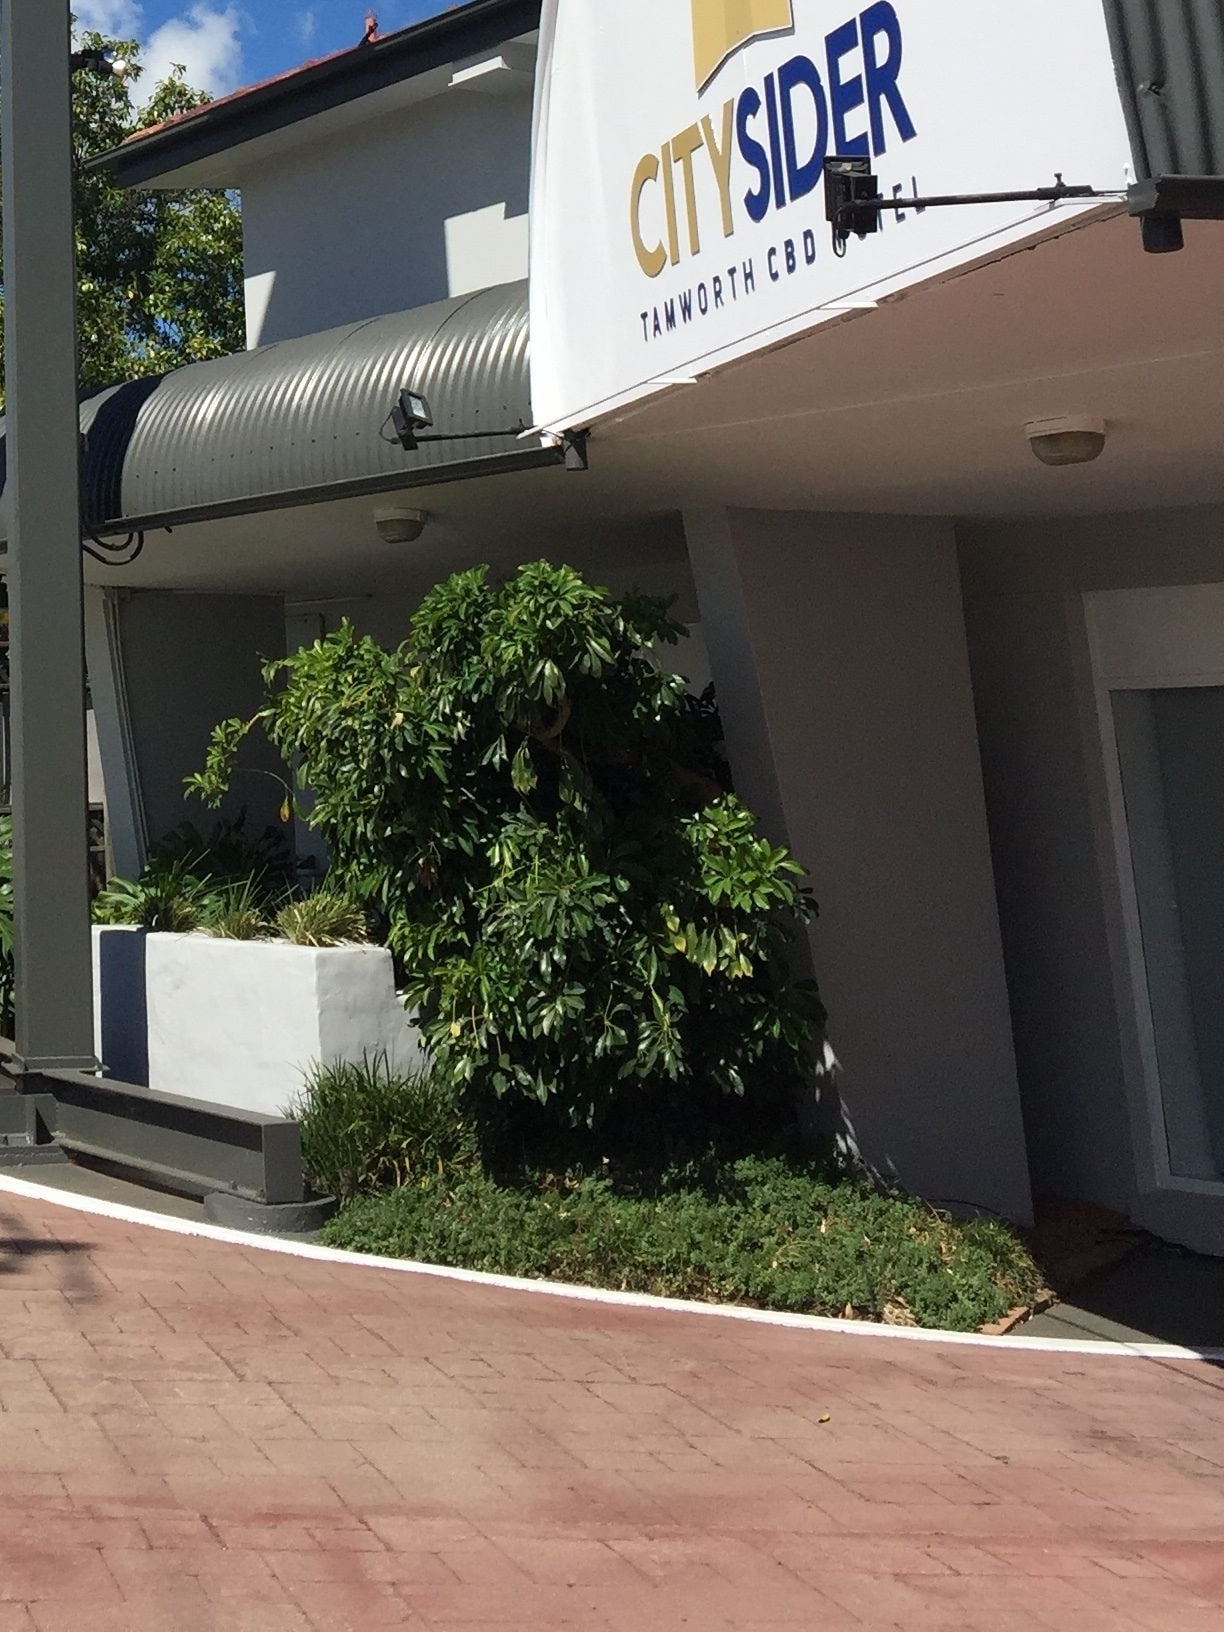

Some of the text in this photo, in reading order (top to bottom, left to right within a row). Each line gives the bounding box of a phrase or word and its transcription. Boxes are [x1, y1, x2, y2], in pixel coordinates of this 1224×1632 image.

[630, 0, 917, 278] CITYSIDER
[640, 258, 755, 342] TAMWORTH
[767, 229, 816, 282] CBD
